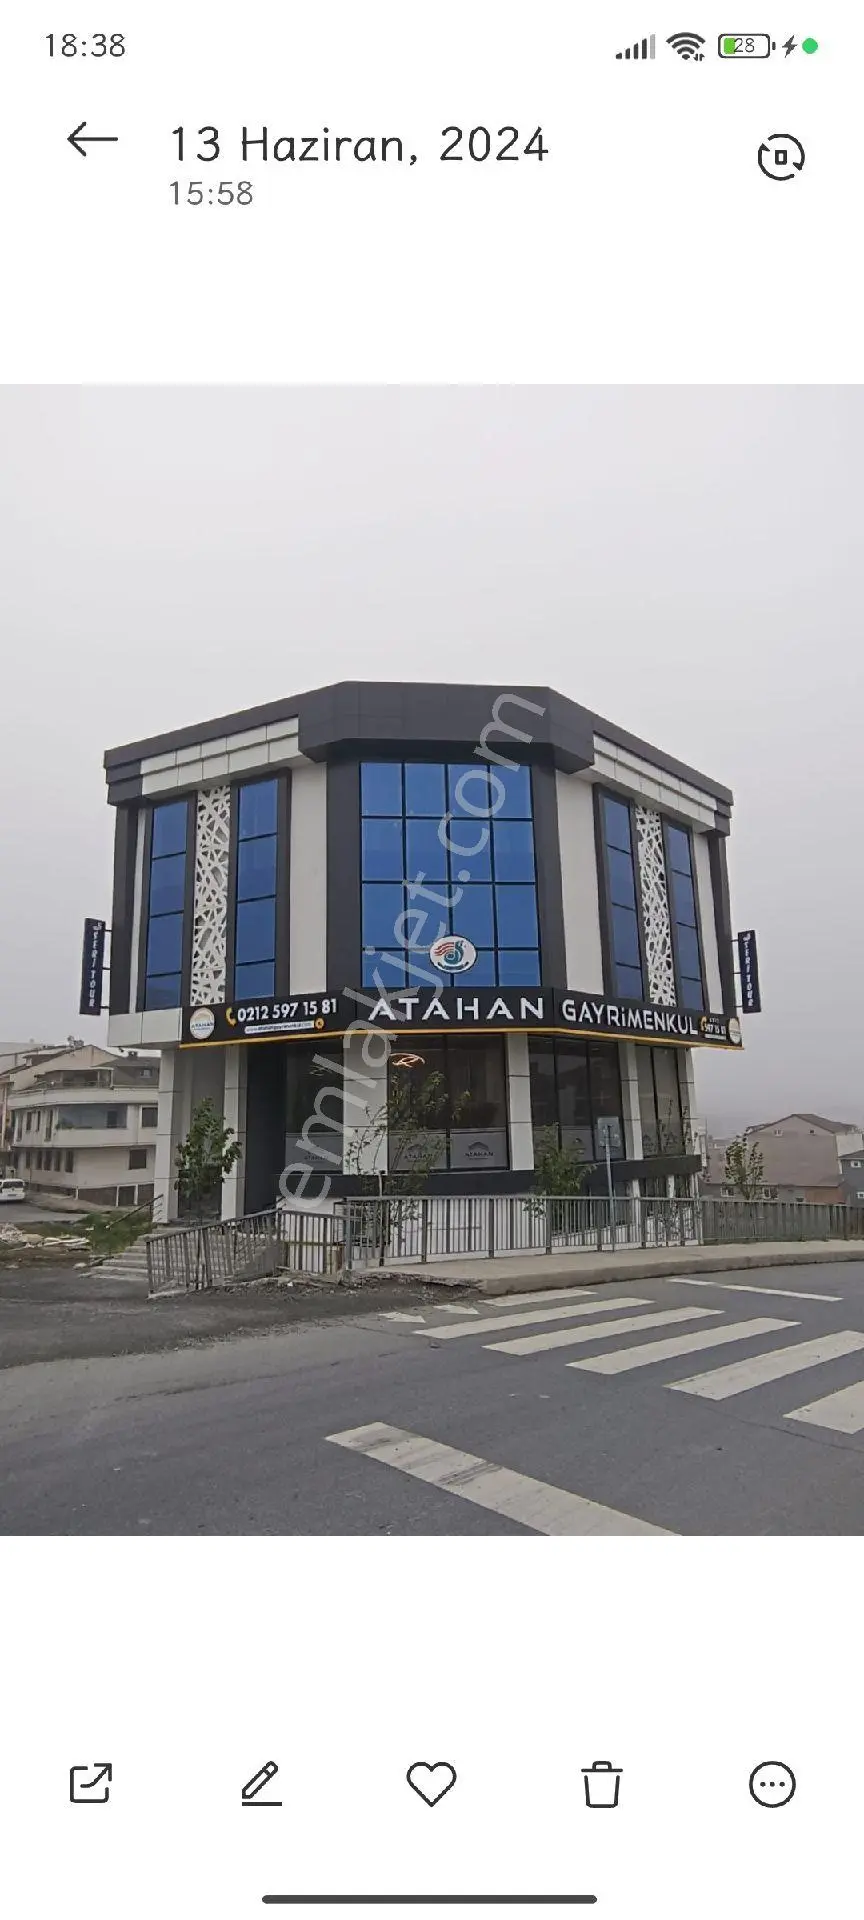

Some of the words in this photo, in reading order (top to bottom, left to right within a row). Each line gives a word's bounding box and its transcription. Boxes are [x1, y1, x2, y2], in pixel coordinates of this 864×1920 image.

[237, 1006, 269, 1022] 0212
[272, 1001, 298, 1020] 597
[303, 999, 318, 1016] 15
[321, 998, 337, 1015] 81
[367, 996, 544, 1021] ATAHAN
